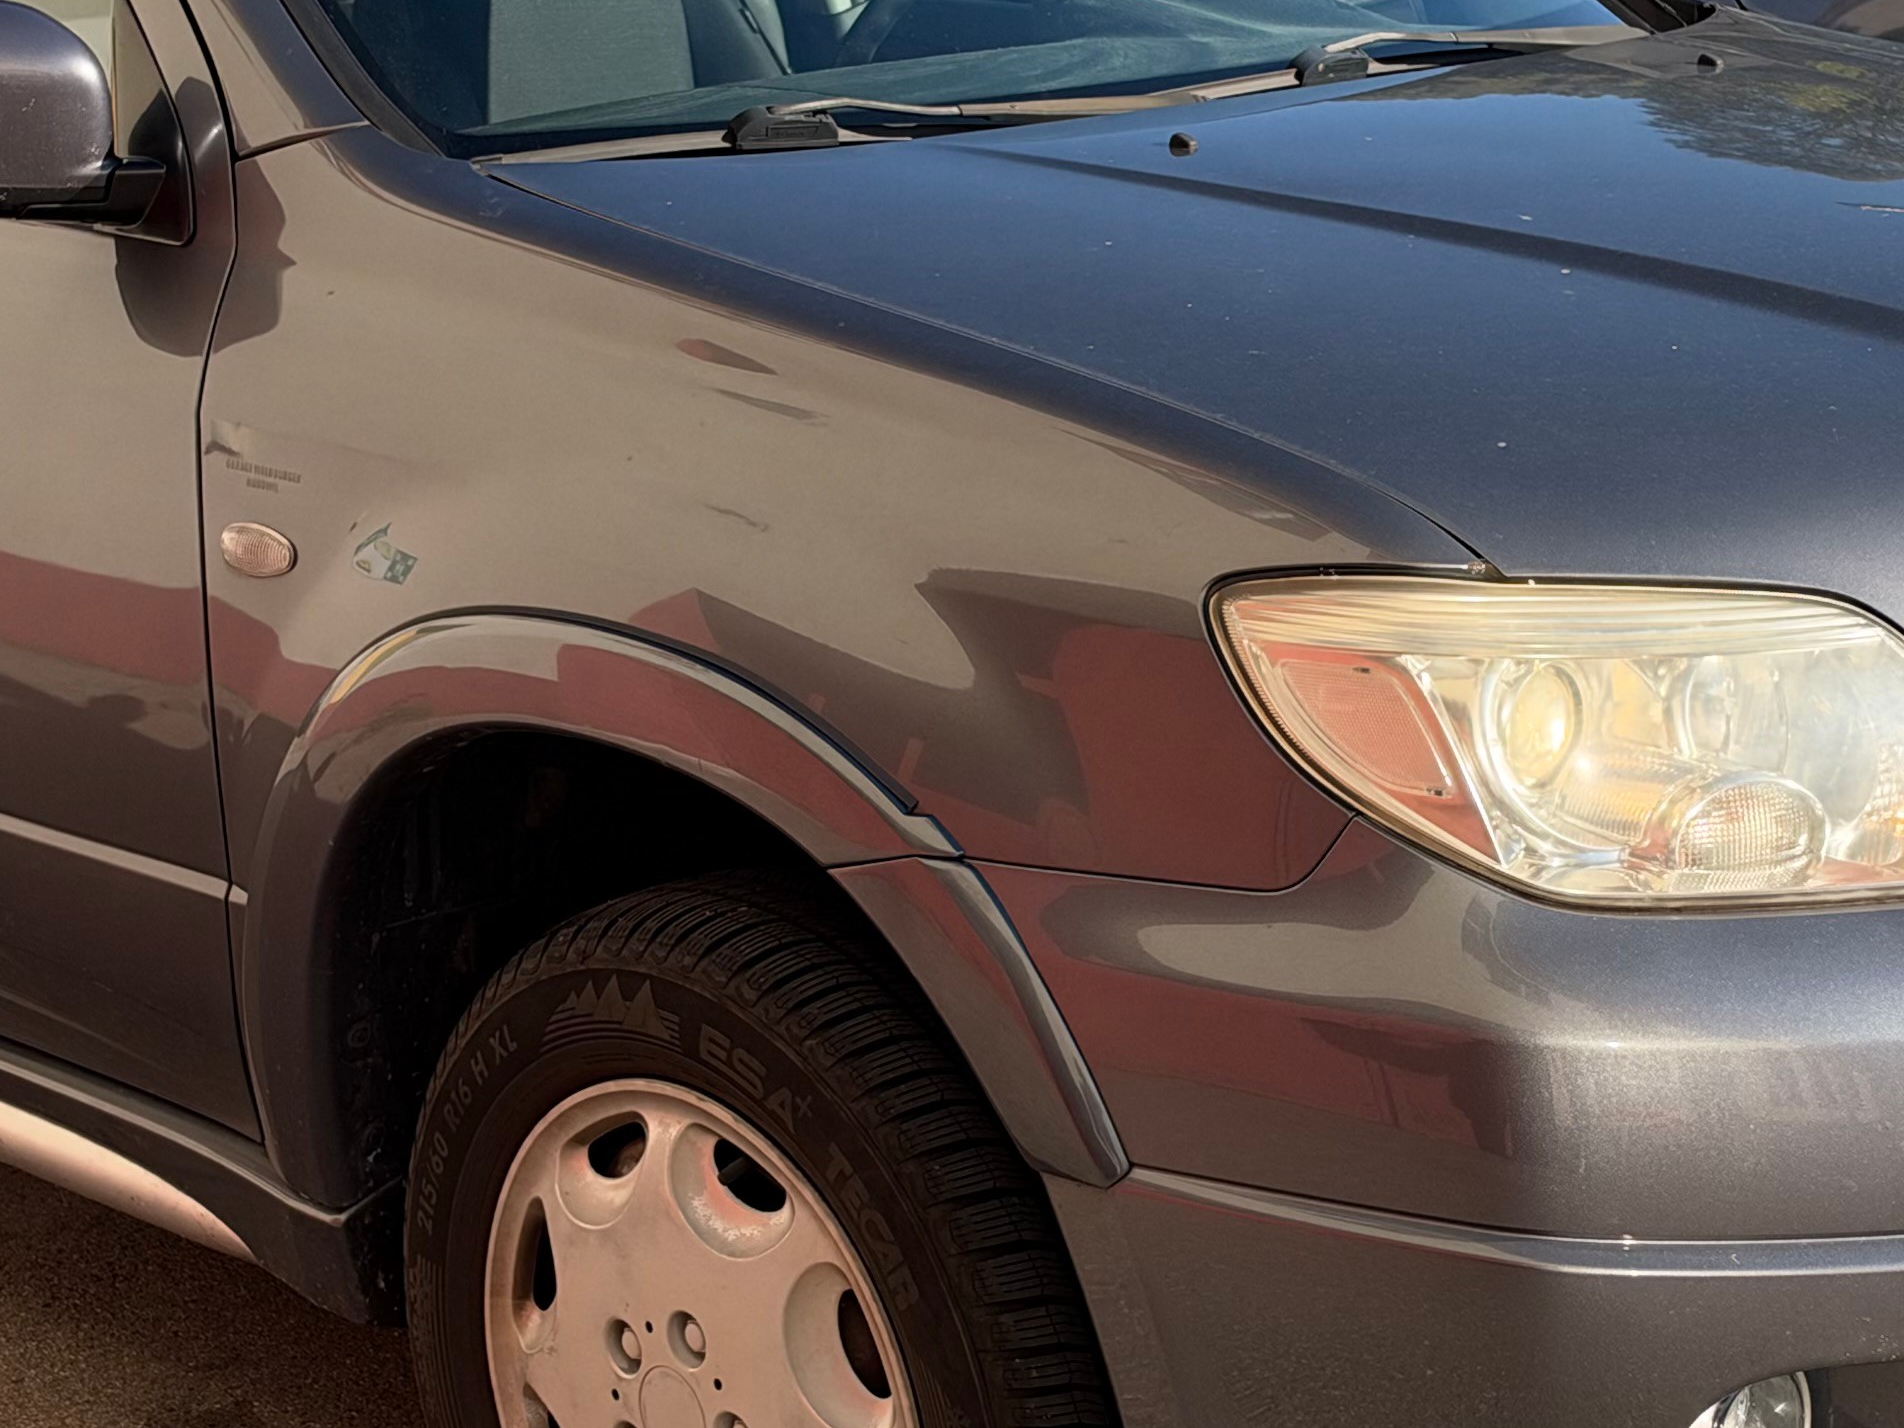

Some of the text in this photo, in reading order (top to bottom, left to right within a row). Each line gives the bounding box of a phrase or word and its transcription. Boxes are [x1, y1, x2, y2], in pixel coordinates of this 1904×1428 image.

[417, 1024, 518, 1236] 215/60 R16 H XL
[822, 1141, 921, 1311] TECAR
